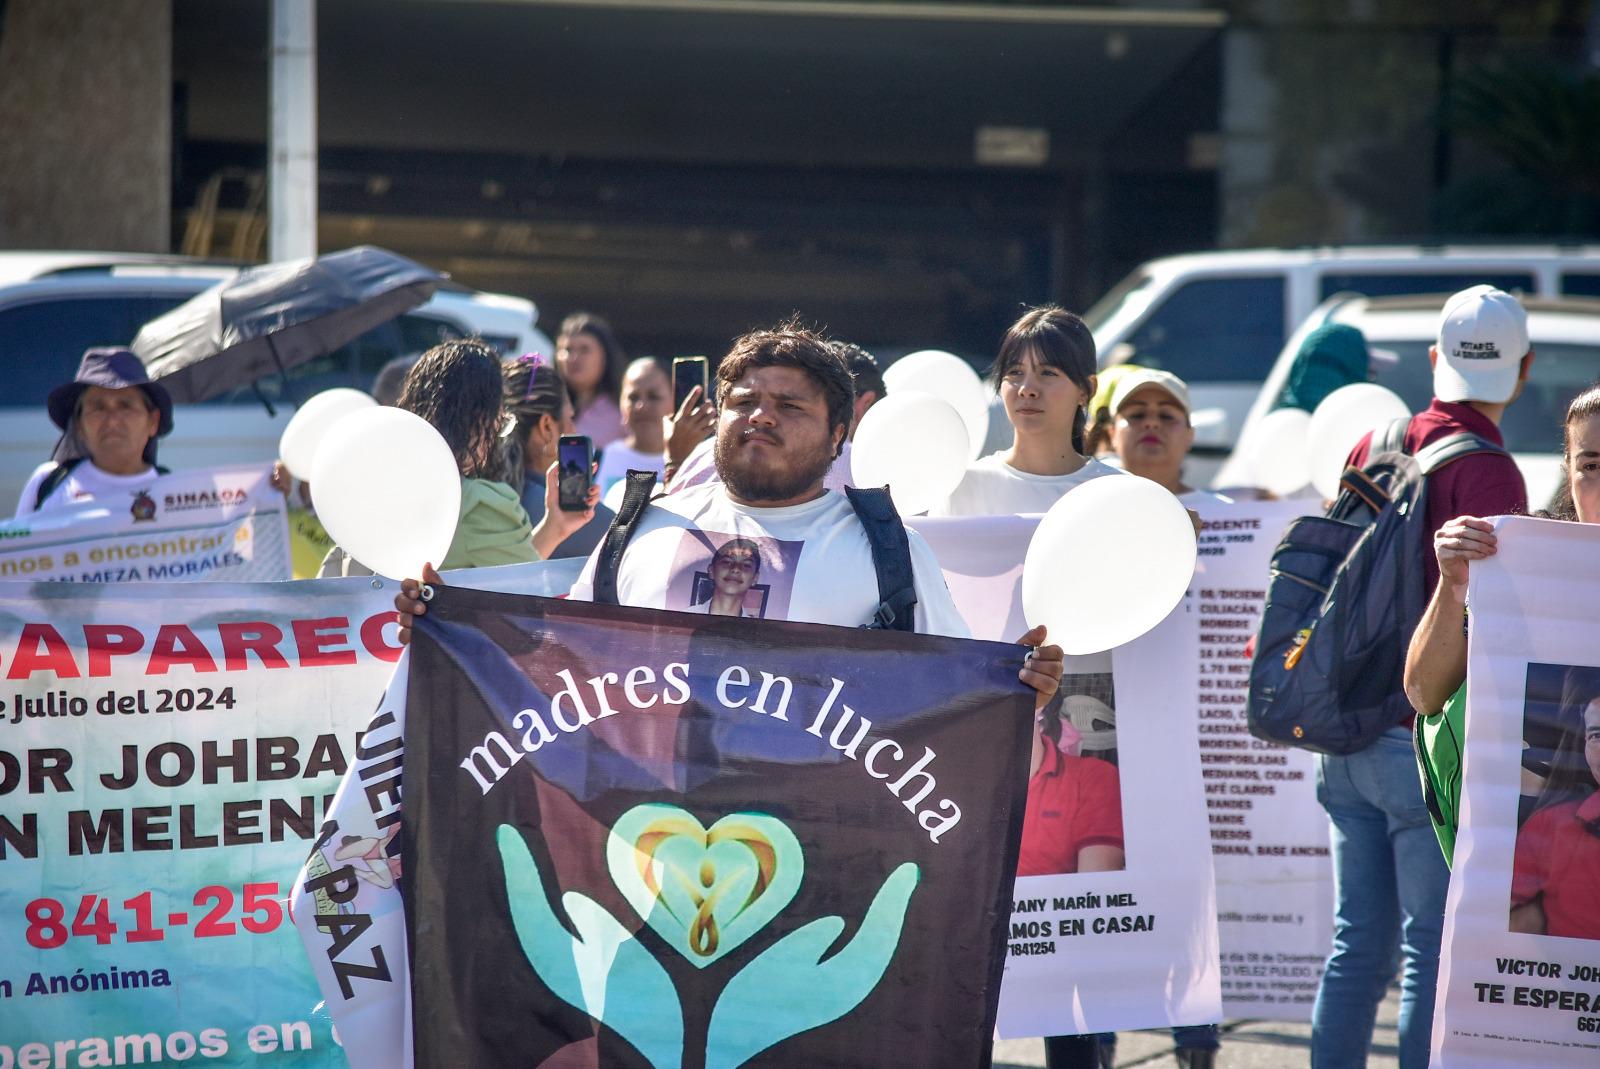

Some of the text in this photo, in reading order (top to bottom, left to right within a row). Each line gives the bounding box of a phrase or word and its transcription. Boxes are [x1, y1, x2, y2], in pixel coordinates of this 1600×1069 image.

[164, 488, 248, 506] SINALOA
[64, 551, 79, 568] a
[89, 531, 225, 564] encontrar
[149, 553, 244, 580] MORALES
[0, 610, 407, 680] APAREC
[10, 690, 88, 725] Julio
[96, 689, 150, 716] del
[155, 686, 237, 714] 2024
[99, 731, 366, 790] JOHBA
[458, 659, 963, 845] madres en lucha
[68, 794, 330, 857] MELEN
[24, 881, 297, 950] 841-25
[1052, 891, 1101, 912] MARÍN
[1105, 893, 1138, 908] MEL
[303, 864, 393, 1001] PAZ
[1058, 917, 1086, 937] EN
[24, 965, 172, 997] Anónima
[1495, 957, 1562, 979] VICTOR
[1474, 982, 1506, 1004] TE
[246, 1020, 313, 1055] en
